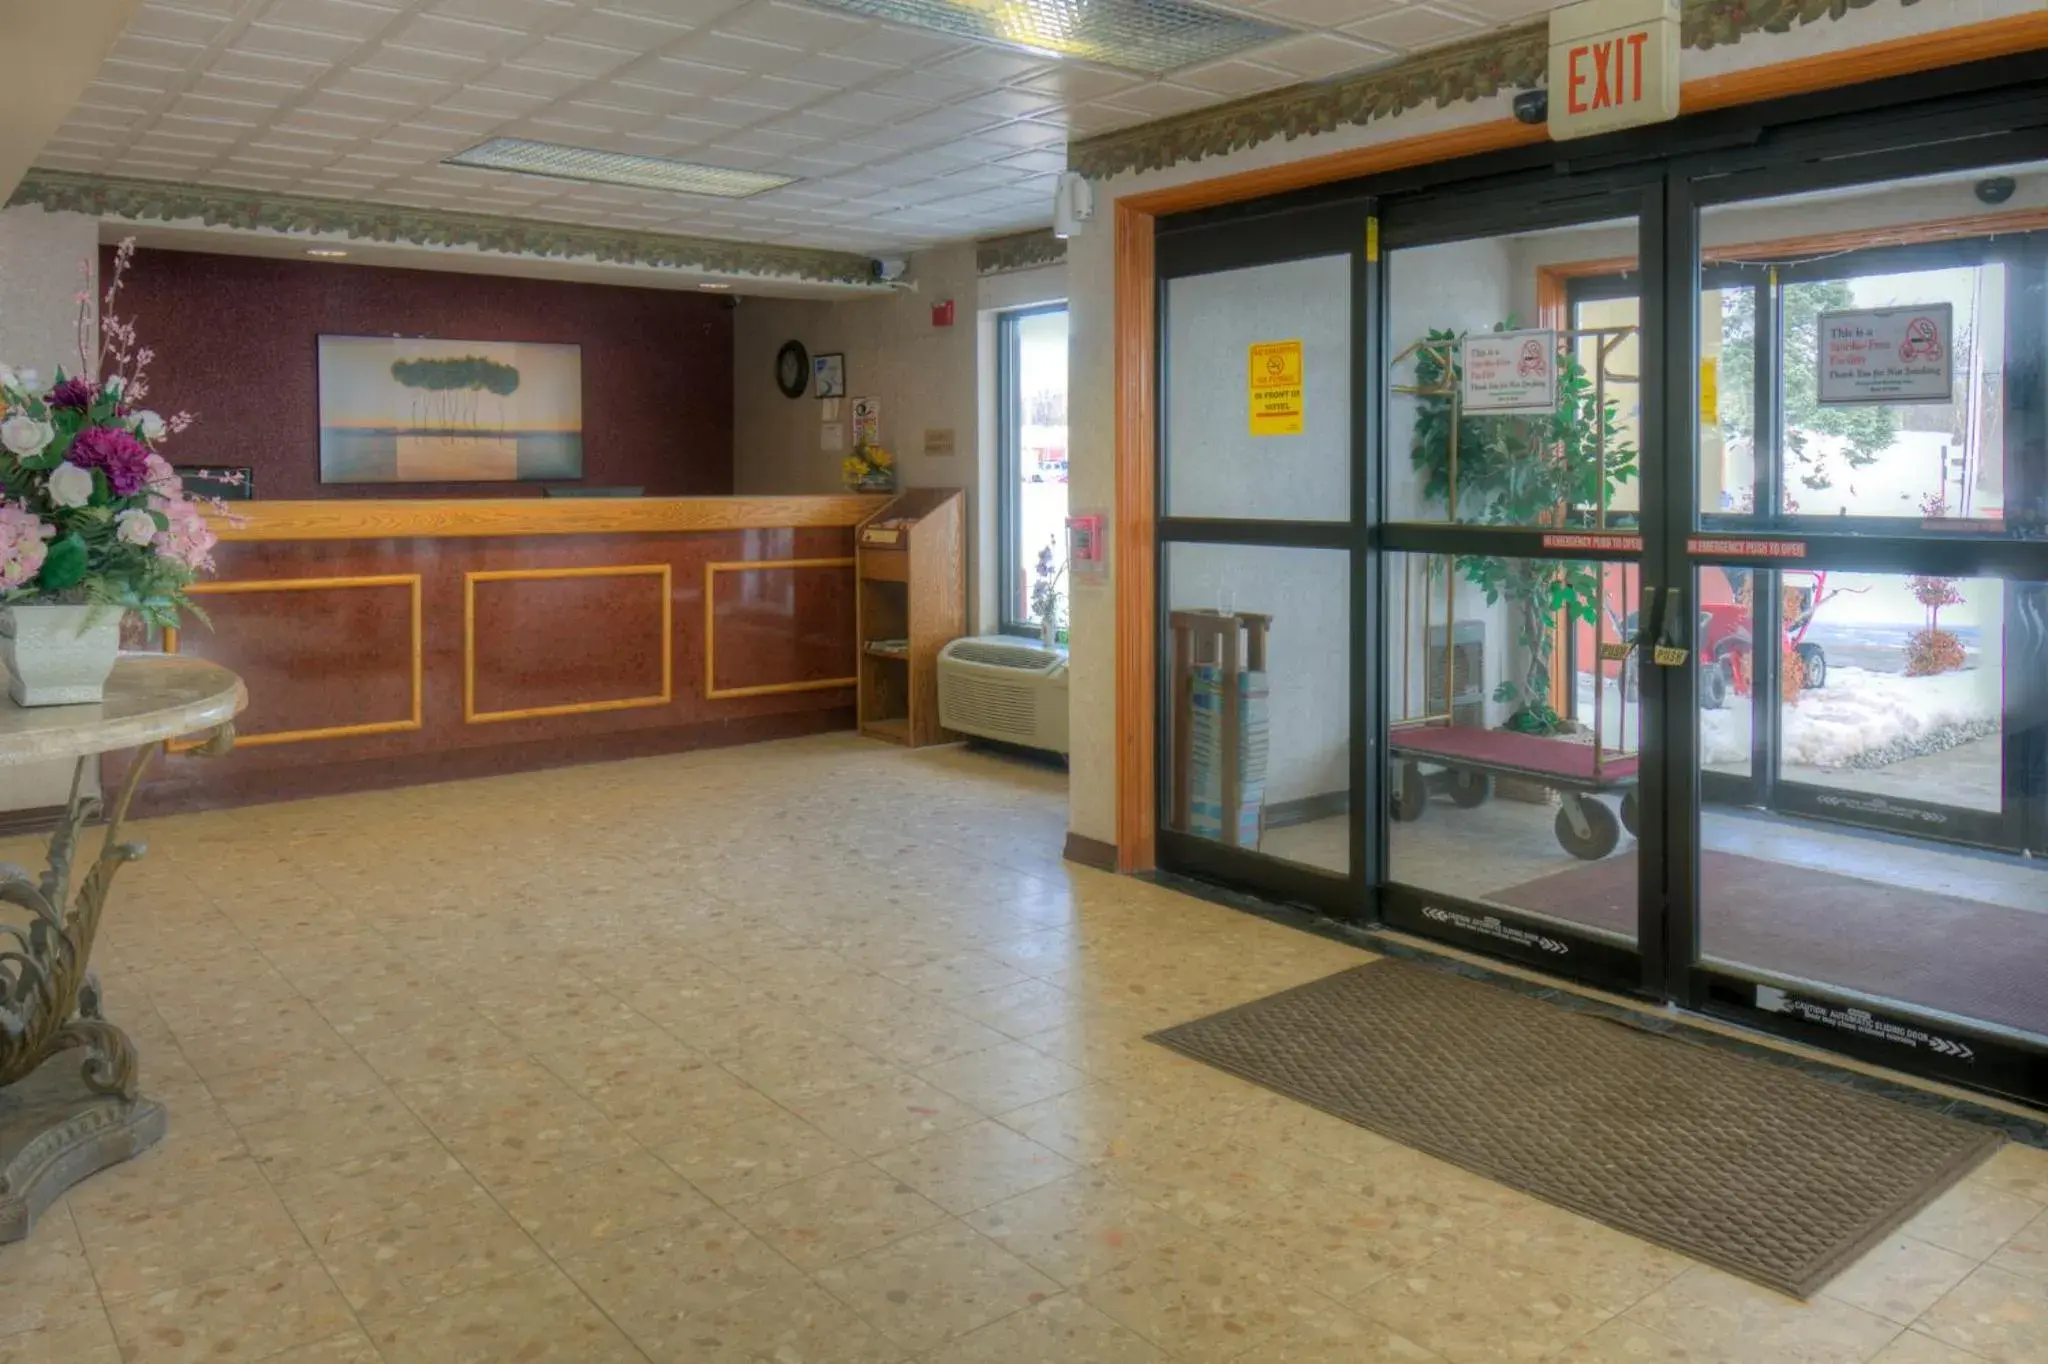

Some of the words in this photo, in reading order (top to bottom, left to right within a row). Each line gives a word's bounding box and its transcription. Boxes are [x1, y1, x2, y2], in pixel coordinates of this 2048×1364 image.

[1568, 31, 1648, 116] EXIT
[1830, 327, 1852, 338] This
[1856, 327, 1865, 337] is
[1657, 649, 1684, 662] PUSH
[1830, 1010, 1874, 1028] AUTOMATIC
[1875, 1021, 1906, 1036] SLIDING
[1906, 1028, 1929, 1042] DOOR
